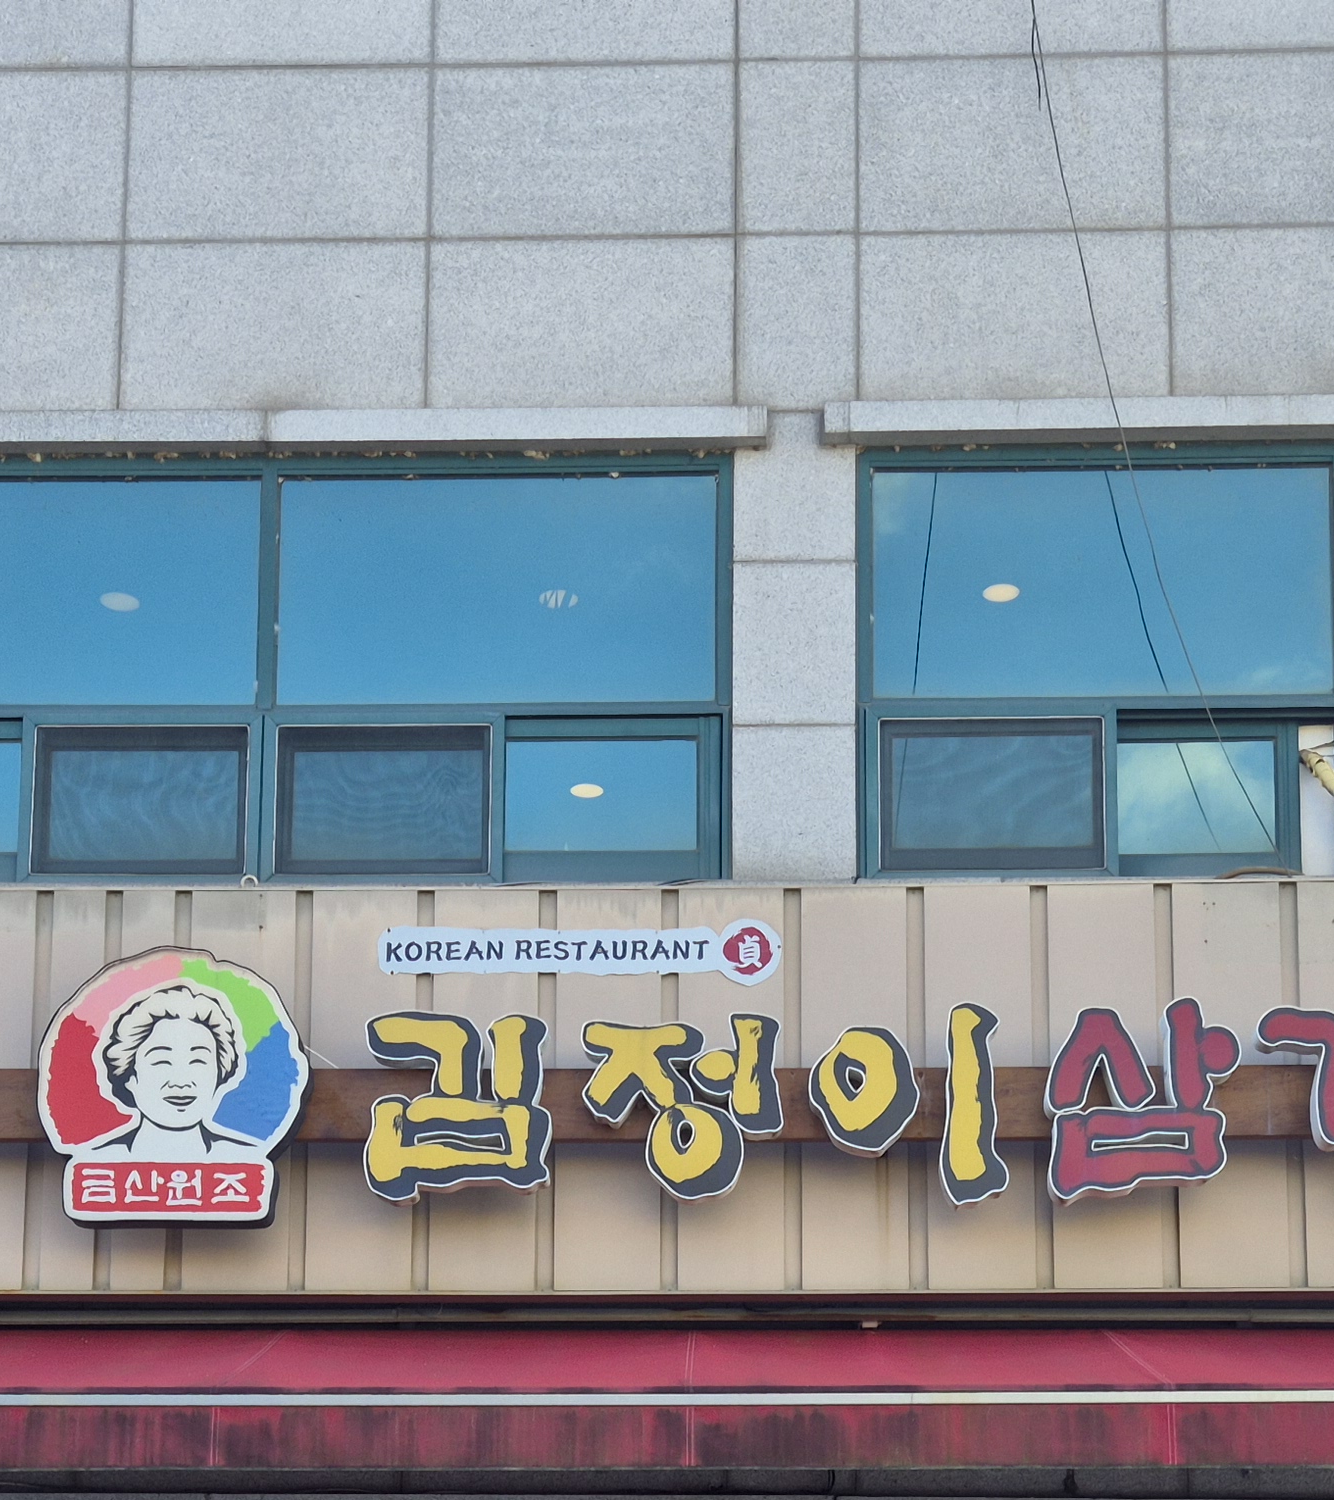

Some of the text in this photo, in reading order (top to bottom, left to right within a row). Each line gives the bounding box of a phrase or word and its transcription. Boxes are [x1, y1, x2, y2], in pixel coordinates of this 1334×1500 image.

[385, 939, 710, 963] KOREAN RESTAURANT
[79, 1169, 254, 1208] 금산원조
